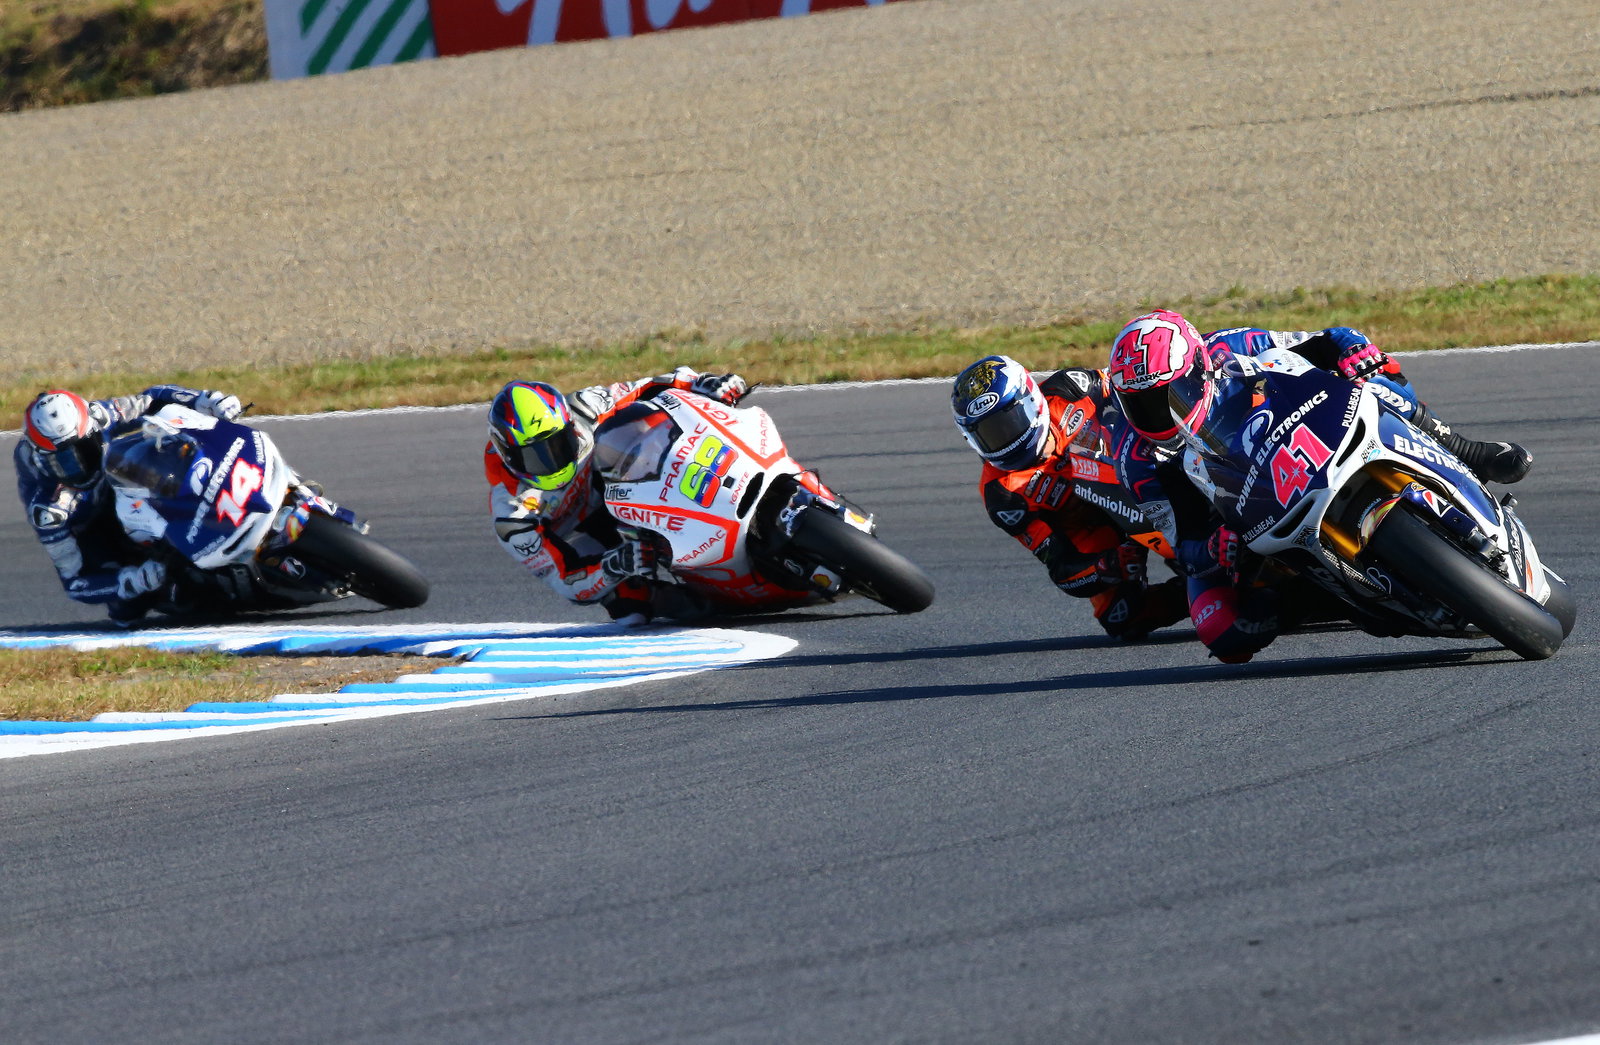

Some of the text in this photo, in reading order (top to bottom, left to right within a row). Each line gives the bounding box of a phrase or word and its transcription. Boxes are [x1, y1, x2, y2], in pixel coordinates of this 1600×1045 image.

[1112, 327, 1174, 380] 41
[1123, 370, 1161, 386] SHARK
[969, 393, 996, 414] Arai
[1342, 387, 1364, 429] PULL&BEAR
[658, 423, 709, 502] PRAMAC
[1235, 464, 1260, 518] POWER
[1255, 390, 1329, 467] ELECTRONICS
[1270, 422, 1336, 510] 41
[216, 457, 265, 528] 14
[729, 471, 750, 505] IGNITE
[1074, 483, 1144, 524] antoniolupi
[613, 505, 689, 532] IGNITE
[1241, 515, 1276, 543] PULL&BEAR
[676, 529, 726, 564] PRAMAC
